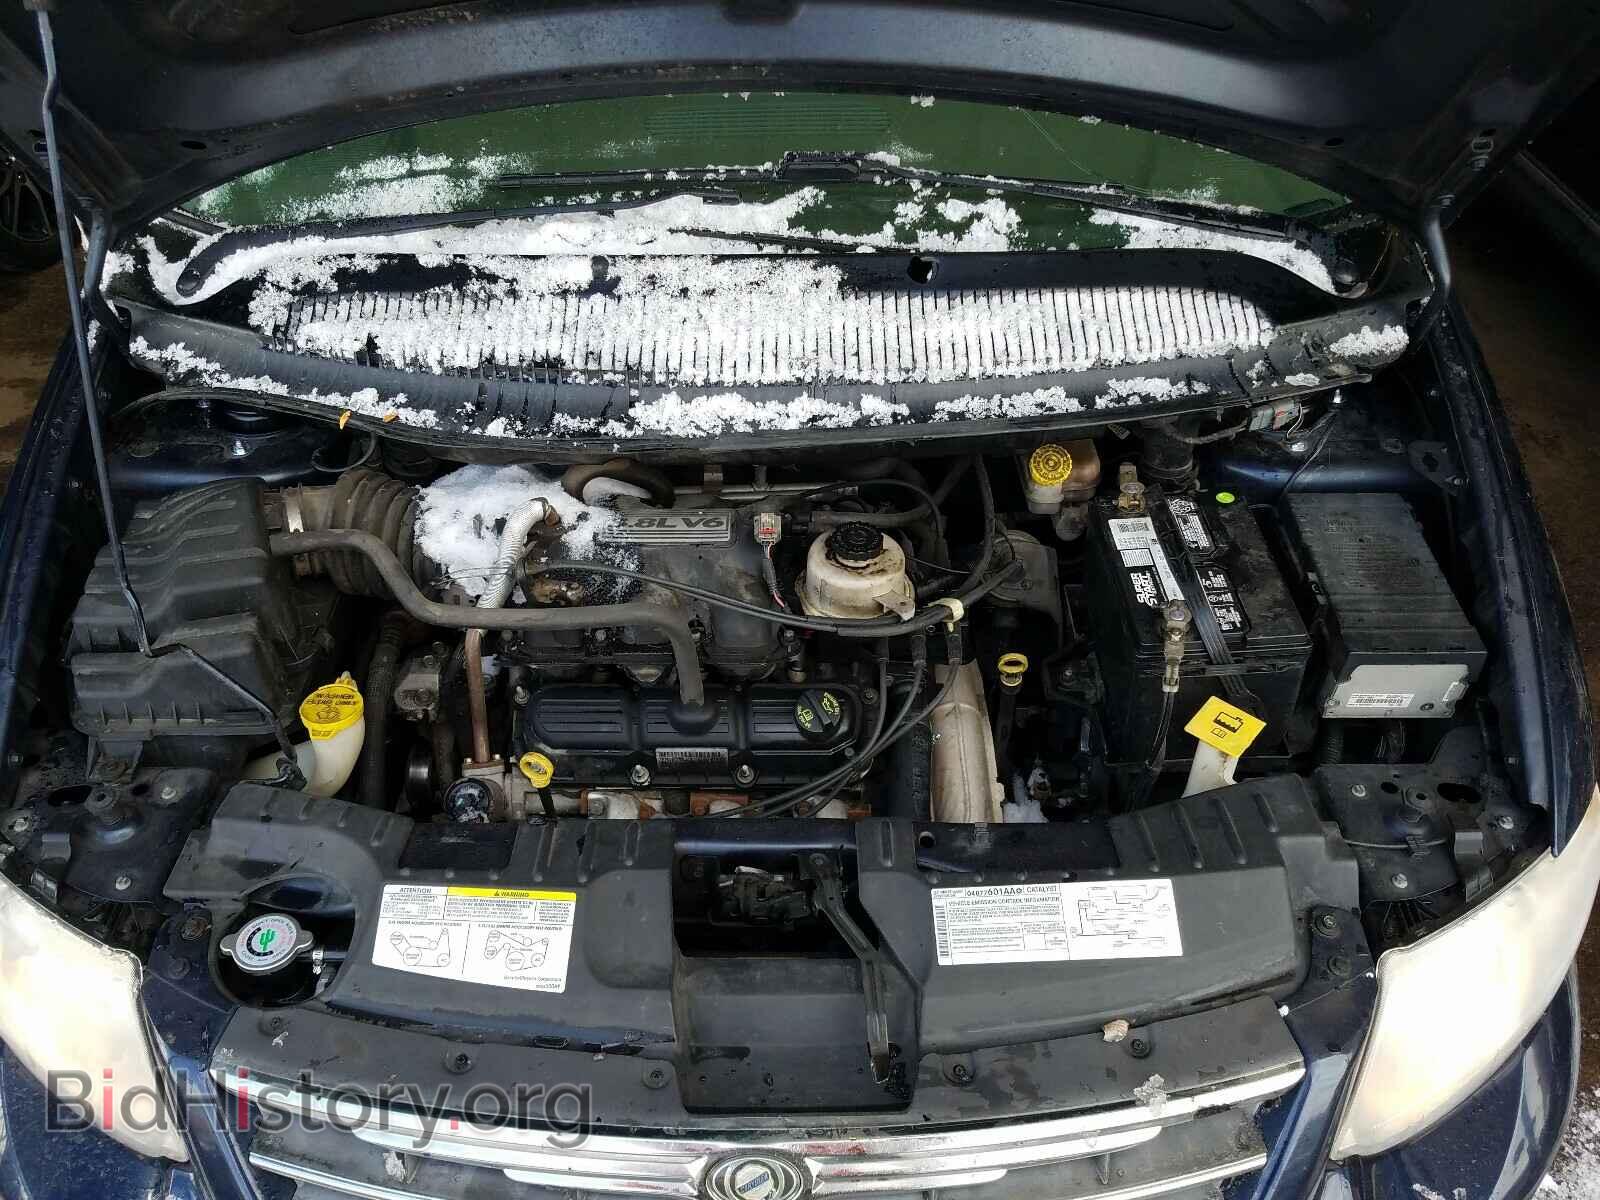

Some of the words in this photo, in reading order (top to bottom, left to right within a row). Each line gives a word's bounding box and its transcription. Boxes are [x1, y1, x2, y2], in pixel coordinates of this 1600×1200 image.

[681, 518, 725, 528] V6
[1130, 572, 1145, 603] SUPER
[500, 890, 530, 898] WARNING
